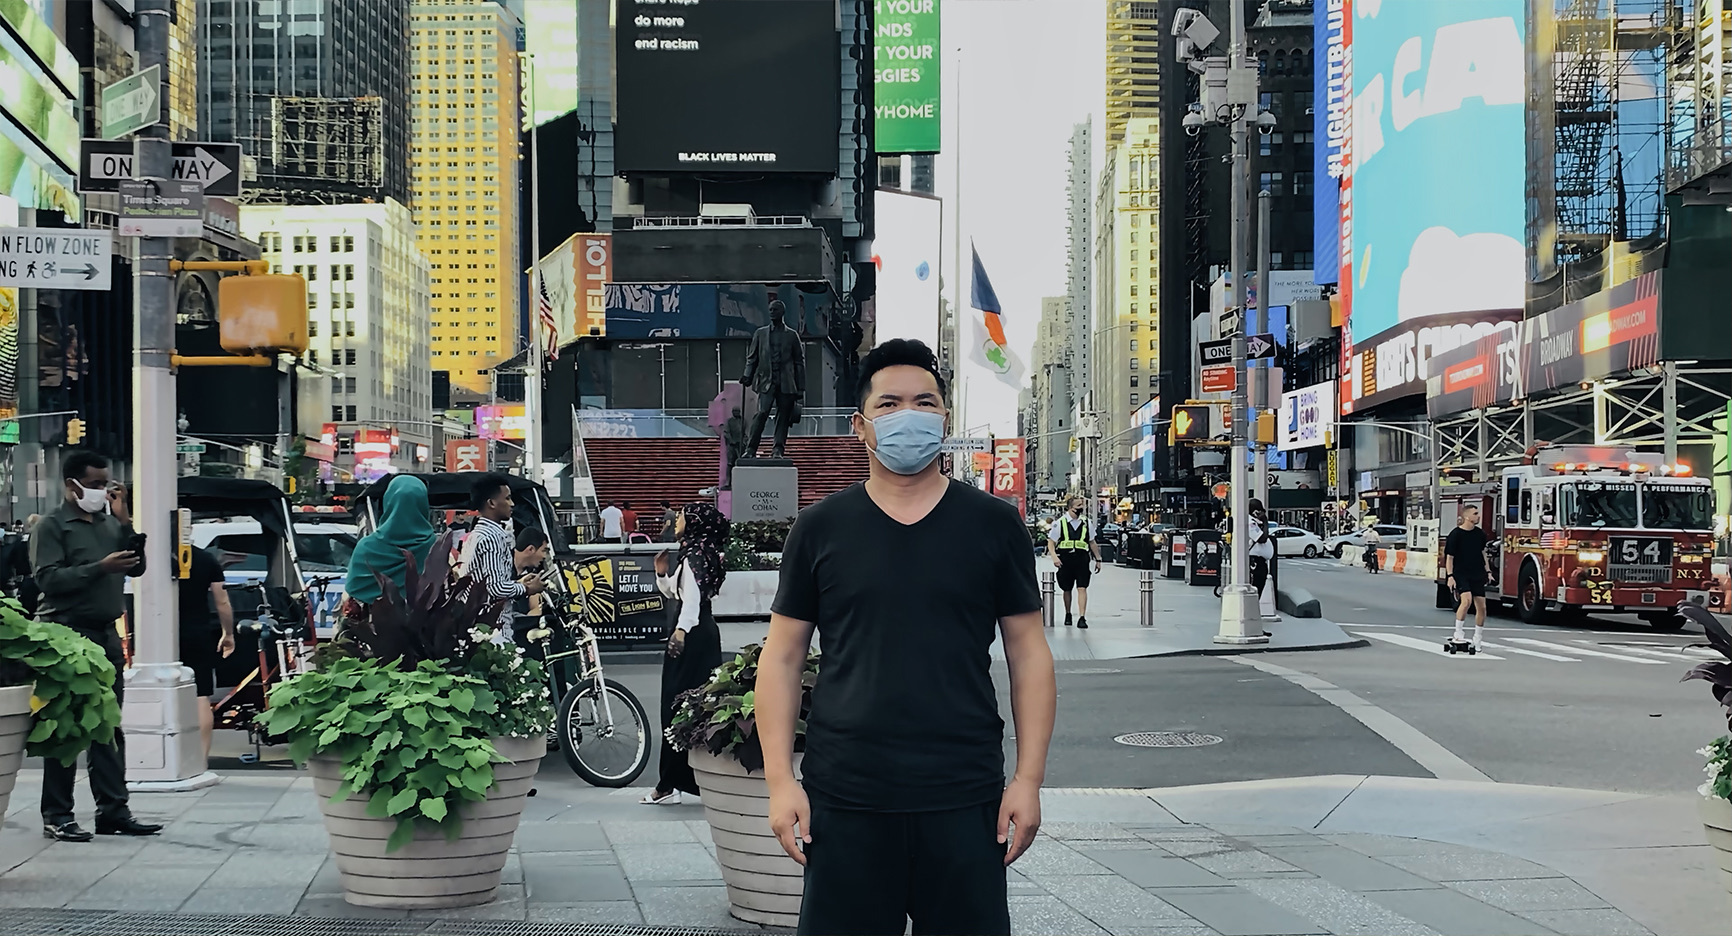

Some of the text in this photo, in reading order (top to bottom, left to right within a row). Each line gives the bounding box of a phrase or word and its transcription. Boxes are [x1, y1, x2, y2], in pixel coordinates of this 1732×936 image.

[634, 14, 685, 27] do more
[874, 22, 912, 38] NDS
[634, 37, 699, 50] end racism
[885, 44, 933, 60] YOUR
[678, 153, 776, 161] BLACK LIVES MATTER
[103, 157, 132, 177] ON
[122, 194, 190, 206] Times Square
[17, 236, 57, 255] FLOW
[62, 237, 101, 256] ZONE
[586, 239, 607, 331] HELLO!
[1210, 346, 1232, 358] ONE
[1540, 329, 1573, 367] BROADWAY
[1300, 390, 1319, 407] BRING
[1300, 407, 1320, 426] GOOD
[1300, 424, 1318, 440] HOME
[995, 443, 1020, 491] tkts
[750, 491, 780, 499] GEORGE
[1622, 540, 1661, 563] 54
[619, 574, 639, 584] LET IT
[619, 584, 653, 593] MOVE YOU
[1590, 589, 1613, 604] 54
